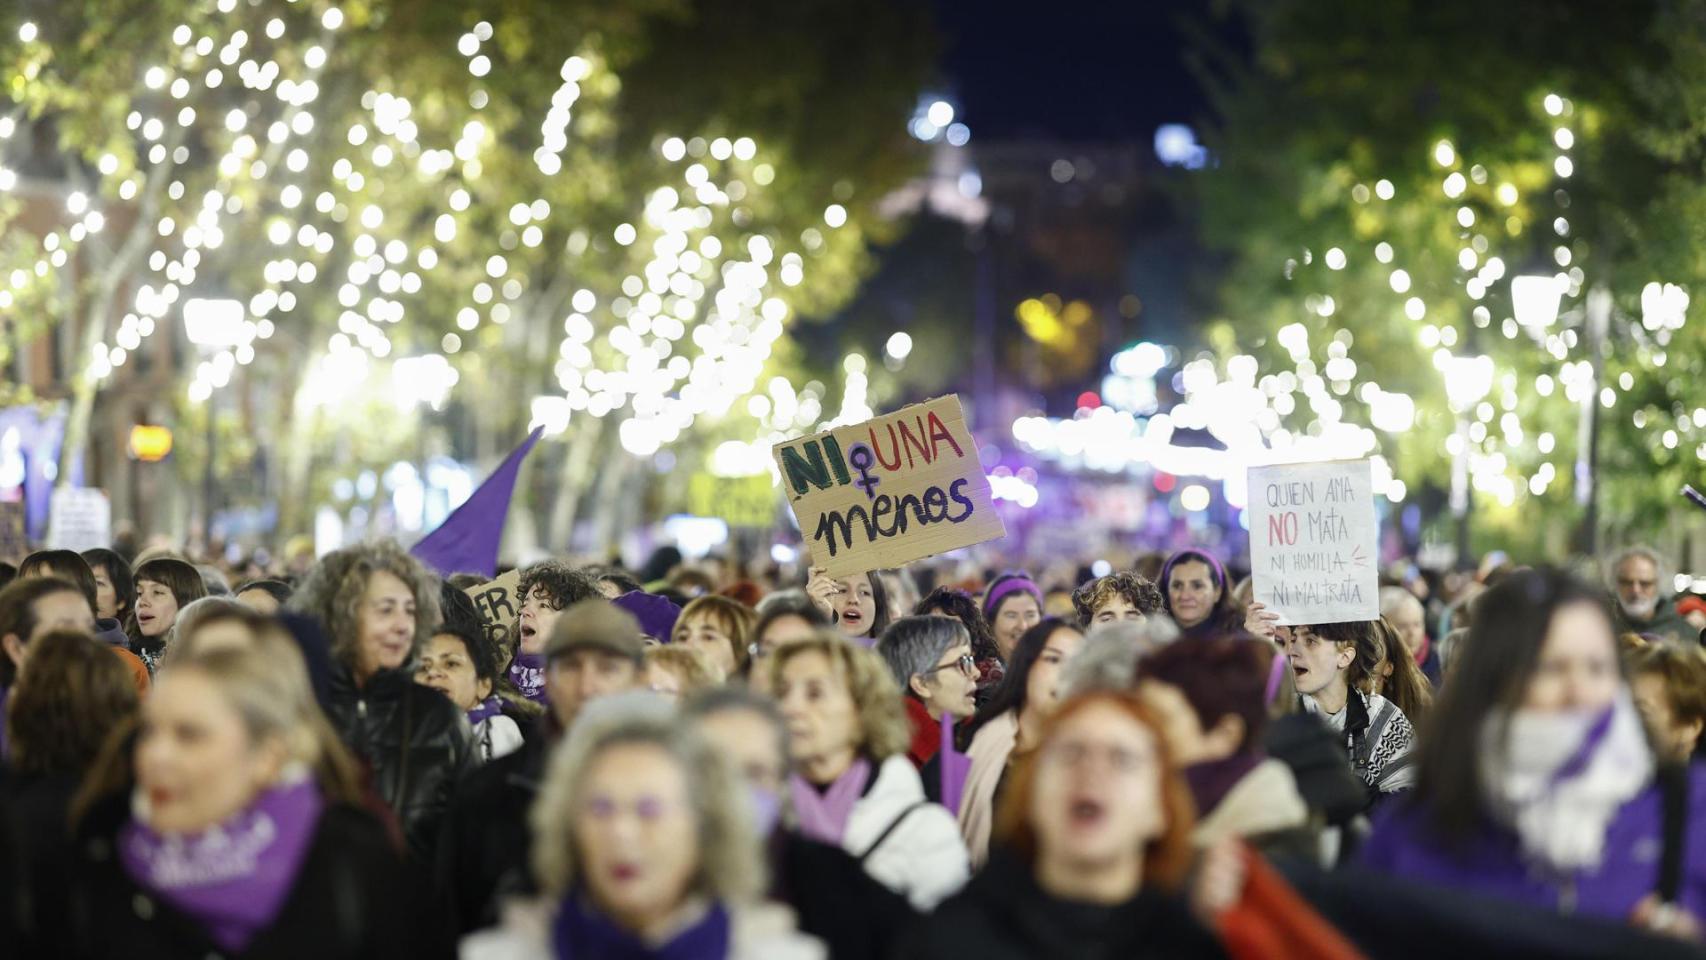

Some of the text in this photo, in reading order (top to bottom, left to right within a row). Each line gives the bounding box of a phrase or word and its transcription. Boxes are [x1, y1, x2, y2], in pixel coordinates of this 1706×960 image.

[780, 410, 964, 495] NI UNA
[1266, 476, 1355, 508] QUIEN AMA
[814, 478, 974, 557] menos
[1268, 511, 1298, 546] NO
[1271, 551, 1348, 574] NI HUMILLA
[1273, 574, 1362, 608] NI MALTRATA
